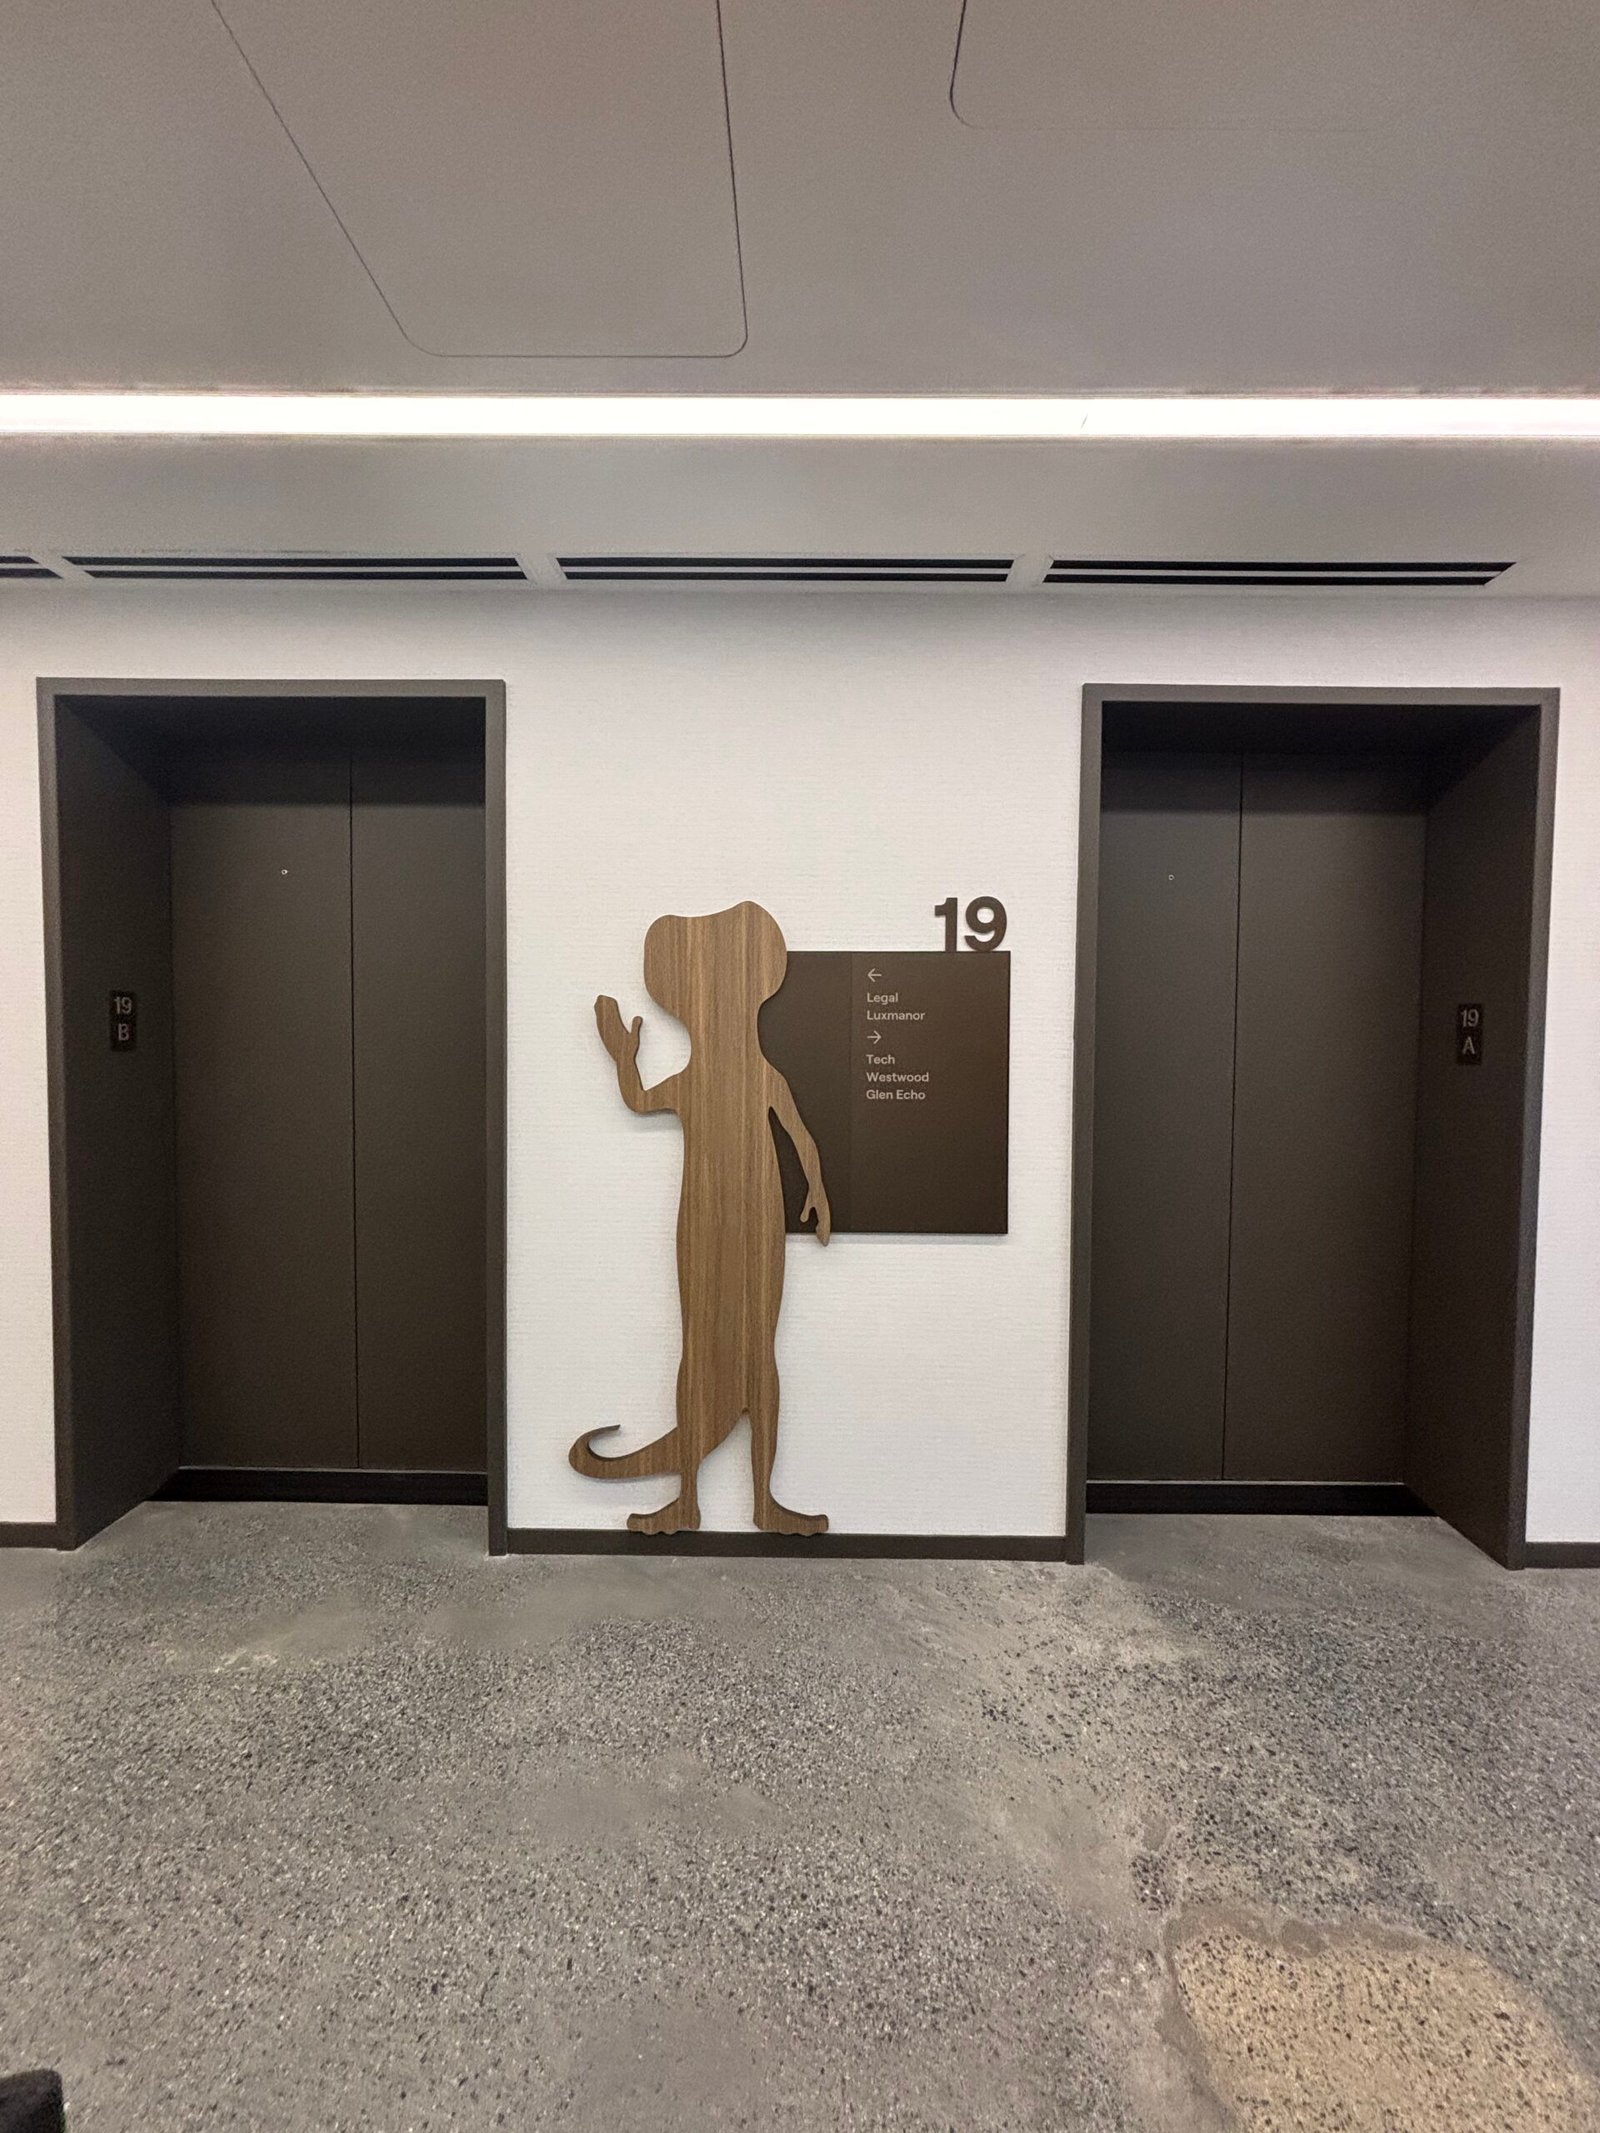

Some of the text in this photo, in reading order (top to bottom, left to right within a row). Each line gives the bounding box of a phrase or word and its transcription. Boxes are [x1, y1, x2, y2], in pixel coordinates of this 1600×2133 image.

[934, 896, 1007, 952] 19
[113, 996, 133, 1014] 19
[866, 991, 899, 1006] Legal
[866, 1009, 925, 1022] Luxmanor
[1461, 1008, 1480, 1028] 19
[117, 1023, 130, 1041] B
[1462, 1036, 1476, 1055] A
[866, 1053, 896, 1065] Tech
[866, 1071, 929, 1083] Westwood
[866, 1089, 926, 1101] Glen Echo
